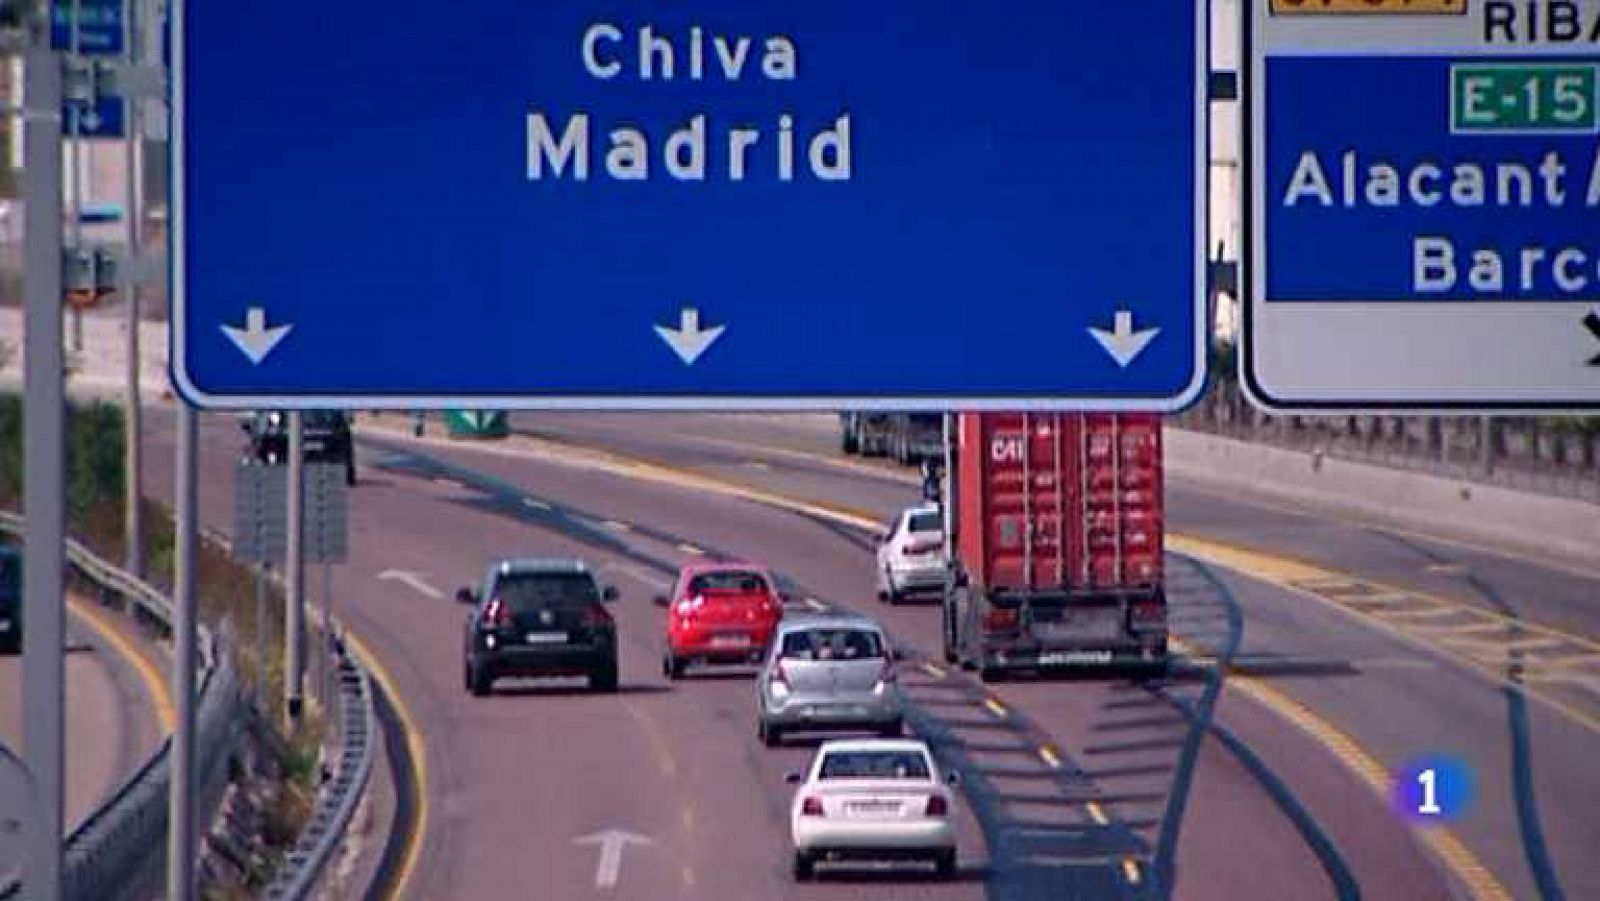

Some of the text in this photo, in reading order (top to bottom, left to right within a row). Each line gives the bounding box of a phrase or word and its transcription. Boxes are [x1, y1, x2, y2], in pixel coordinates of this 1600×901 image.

[1483, 1, 1600, 42] RIB
[581, 23, 797, 81] Chiva
[1461, 76, 1587, 122] E-15
[526, 113, 851, 181] Madrid
[1282, 149, 1567, 208] Alacant
[1412, 236, 1600, 293] Barc
